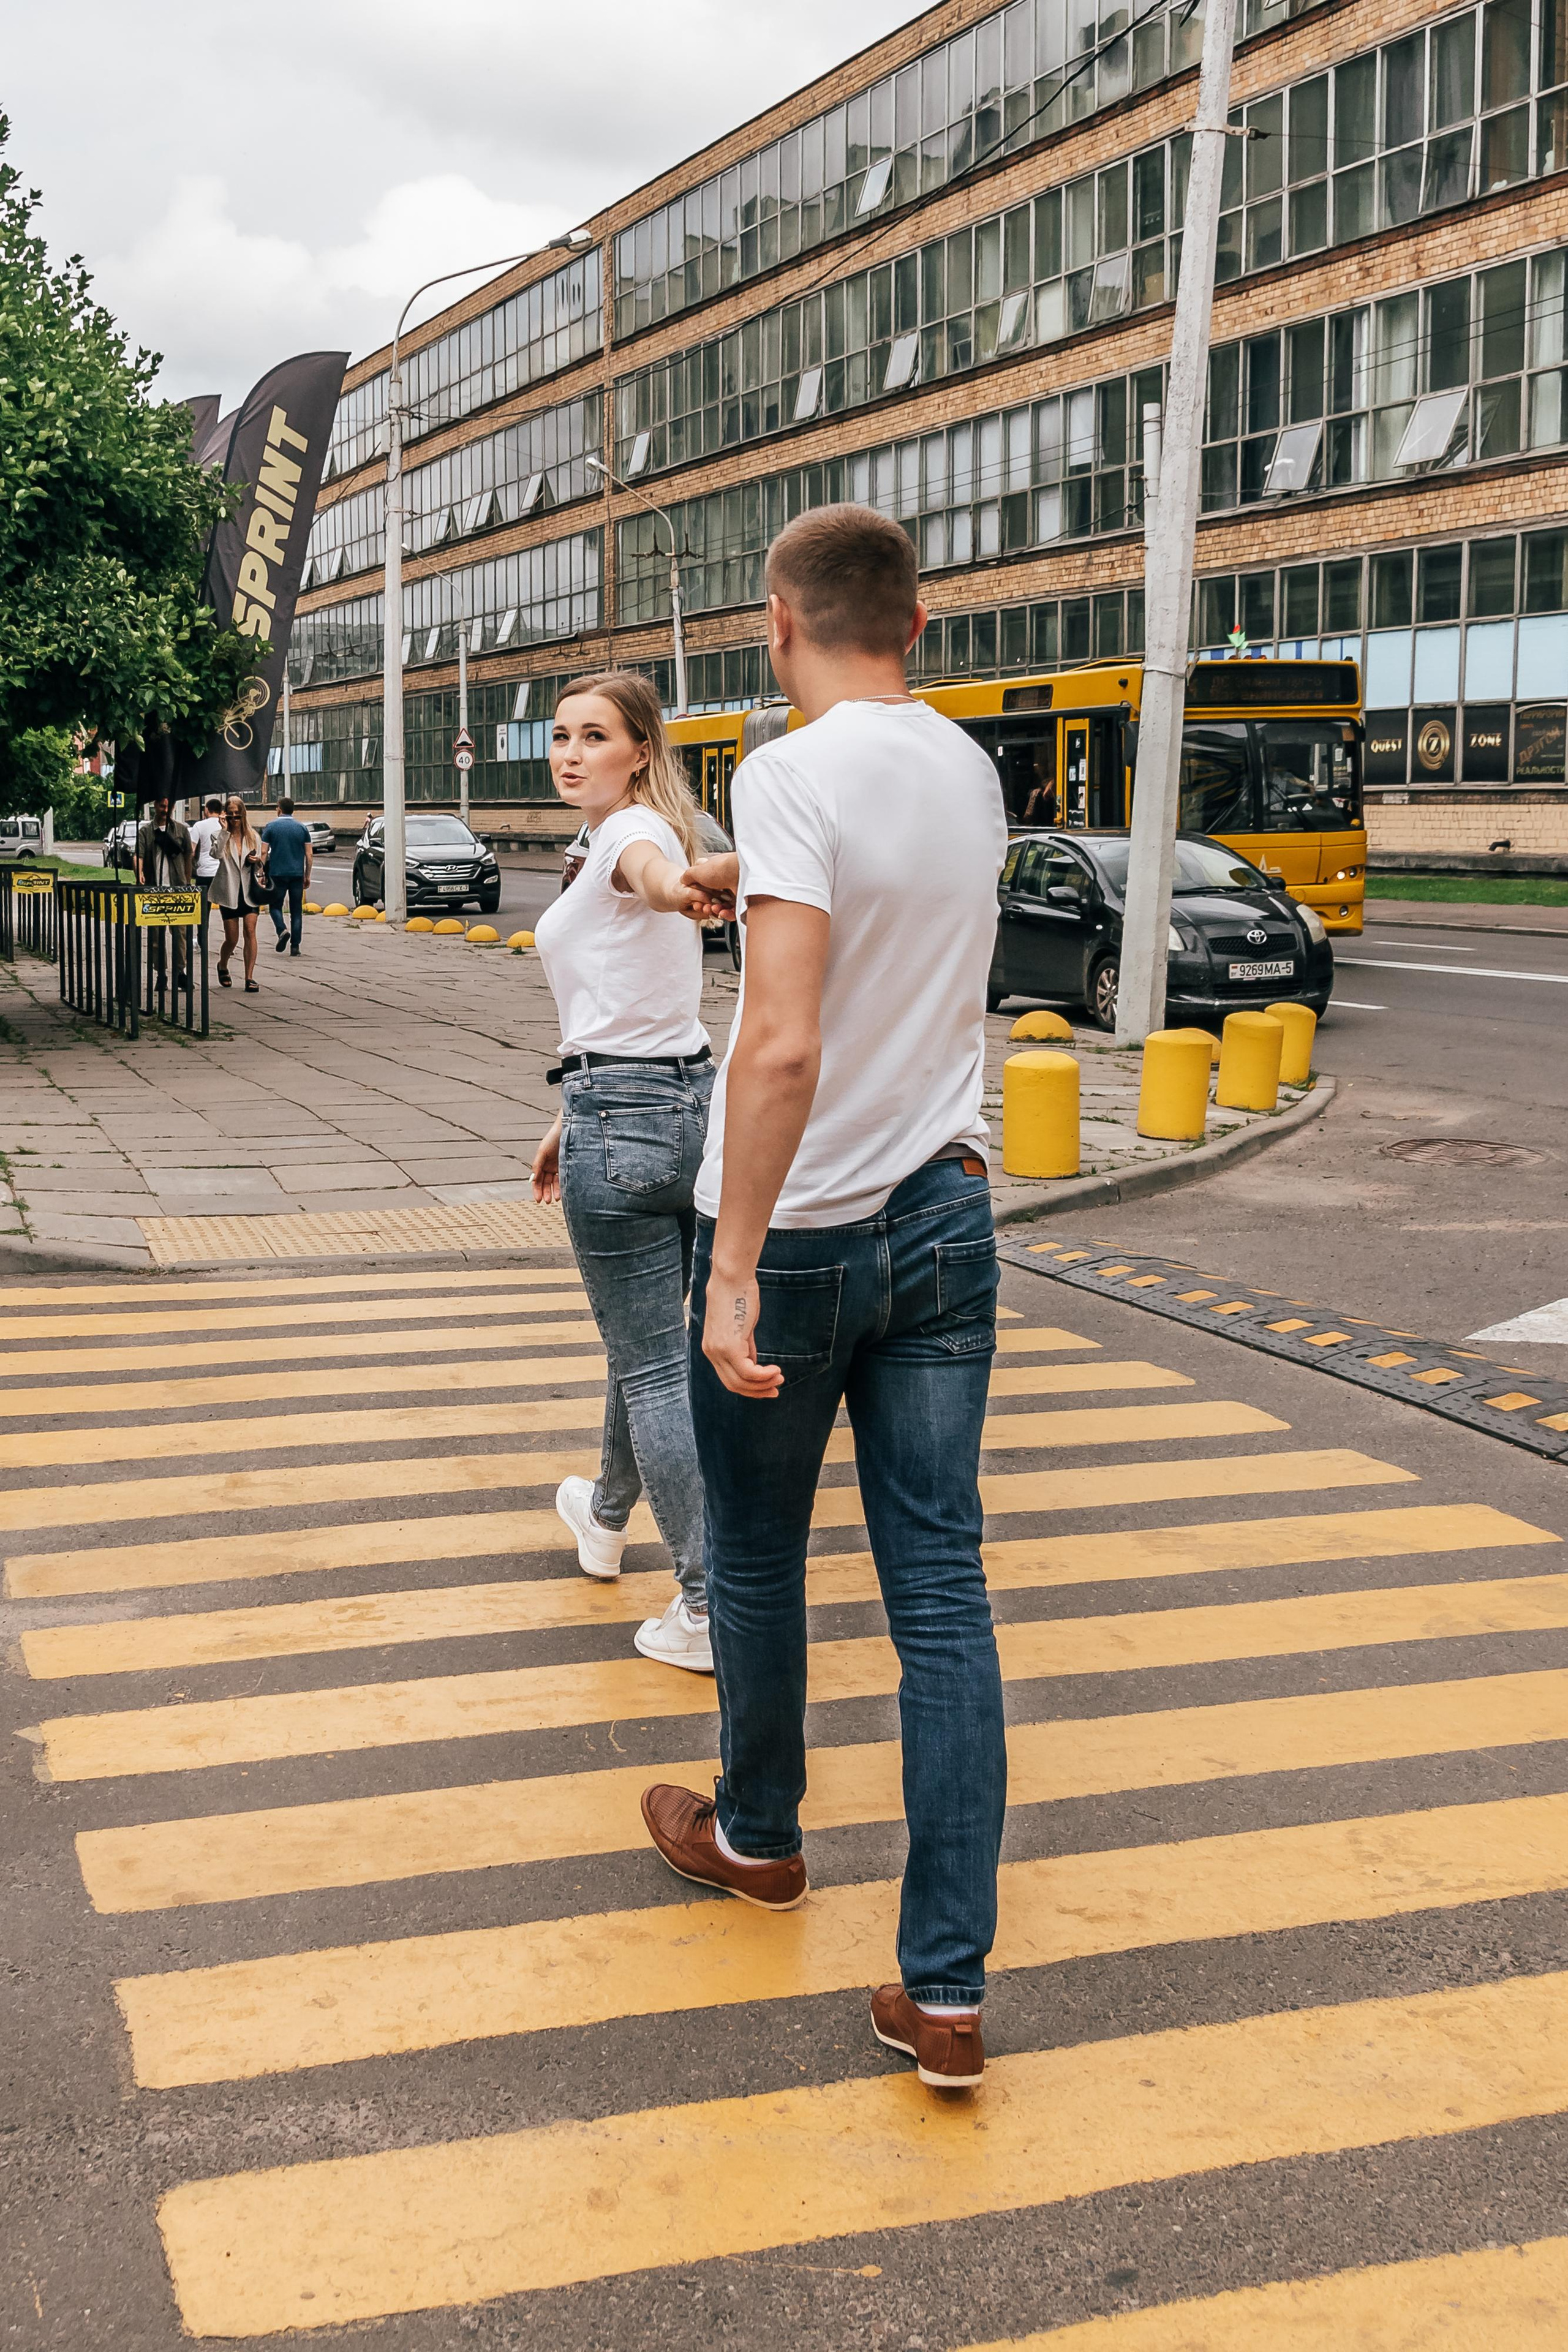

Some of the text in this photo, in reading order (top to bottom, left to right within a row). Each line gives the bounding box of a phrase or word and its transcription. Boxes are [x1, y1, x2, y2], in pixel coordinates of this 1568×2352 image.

[232, 405, 309, 652] SPRINT
[1371, 738, 1403, 753] QUEST
[1469, 733, 1502, 748] ZONE
[458, 756, 470, 764] 40
[1239, 962, 1292, 976] 9269MA-5
